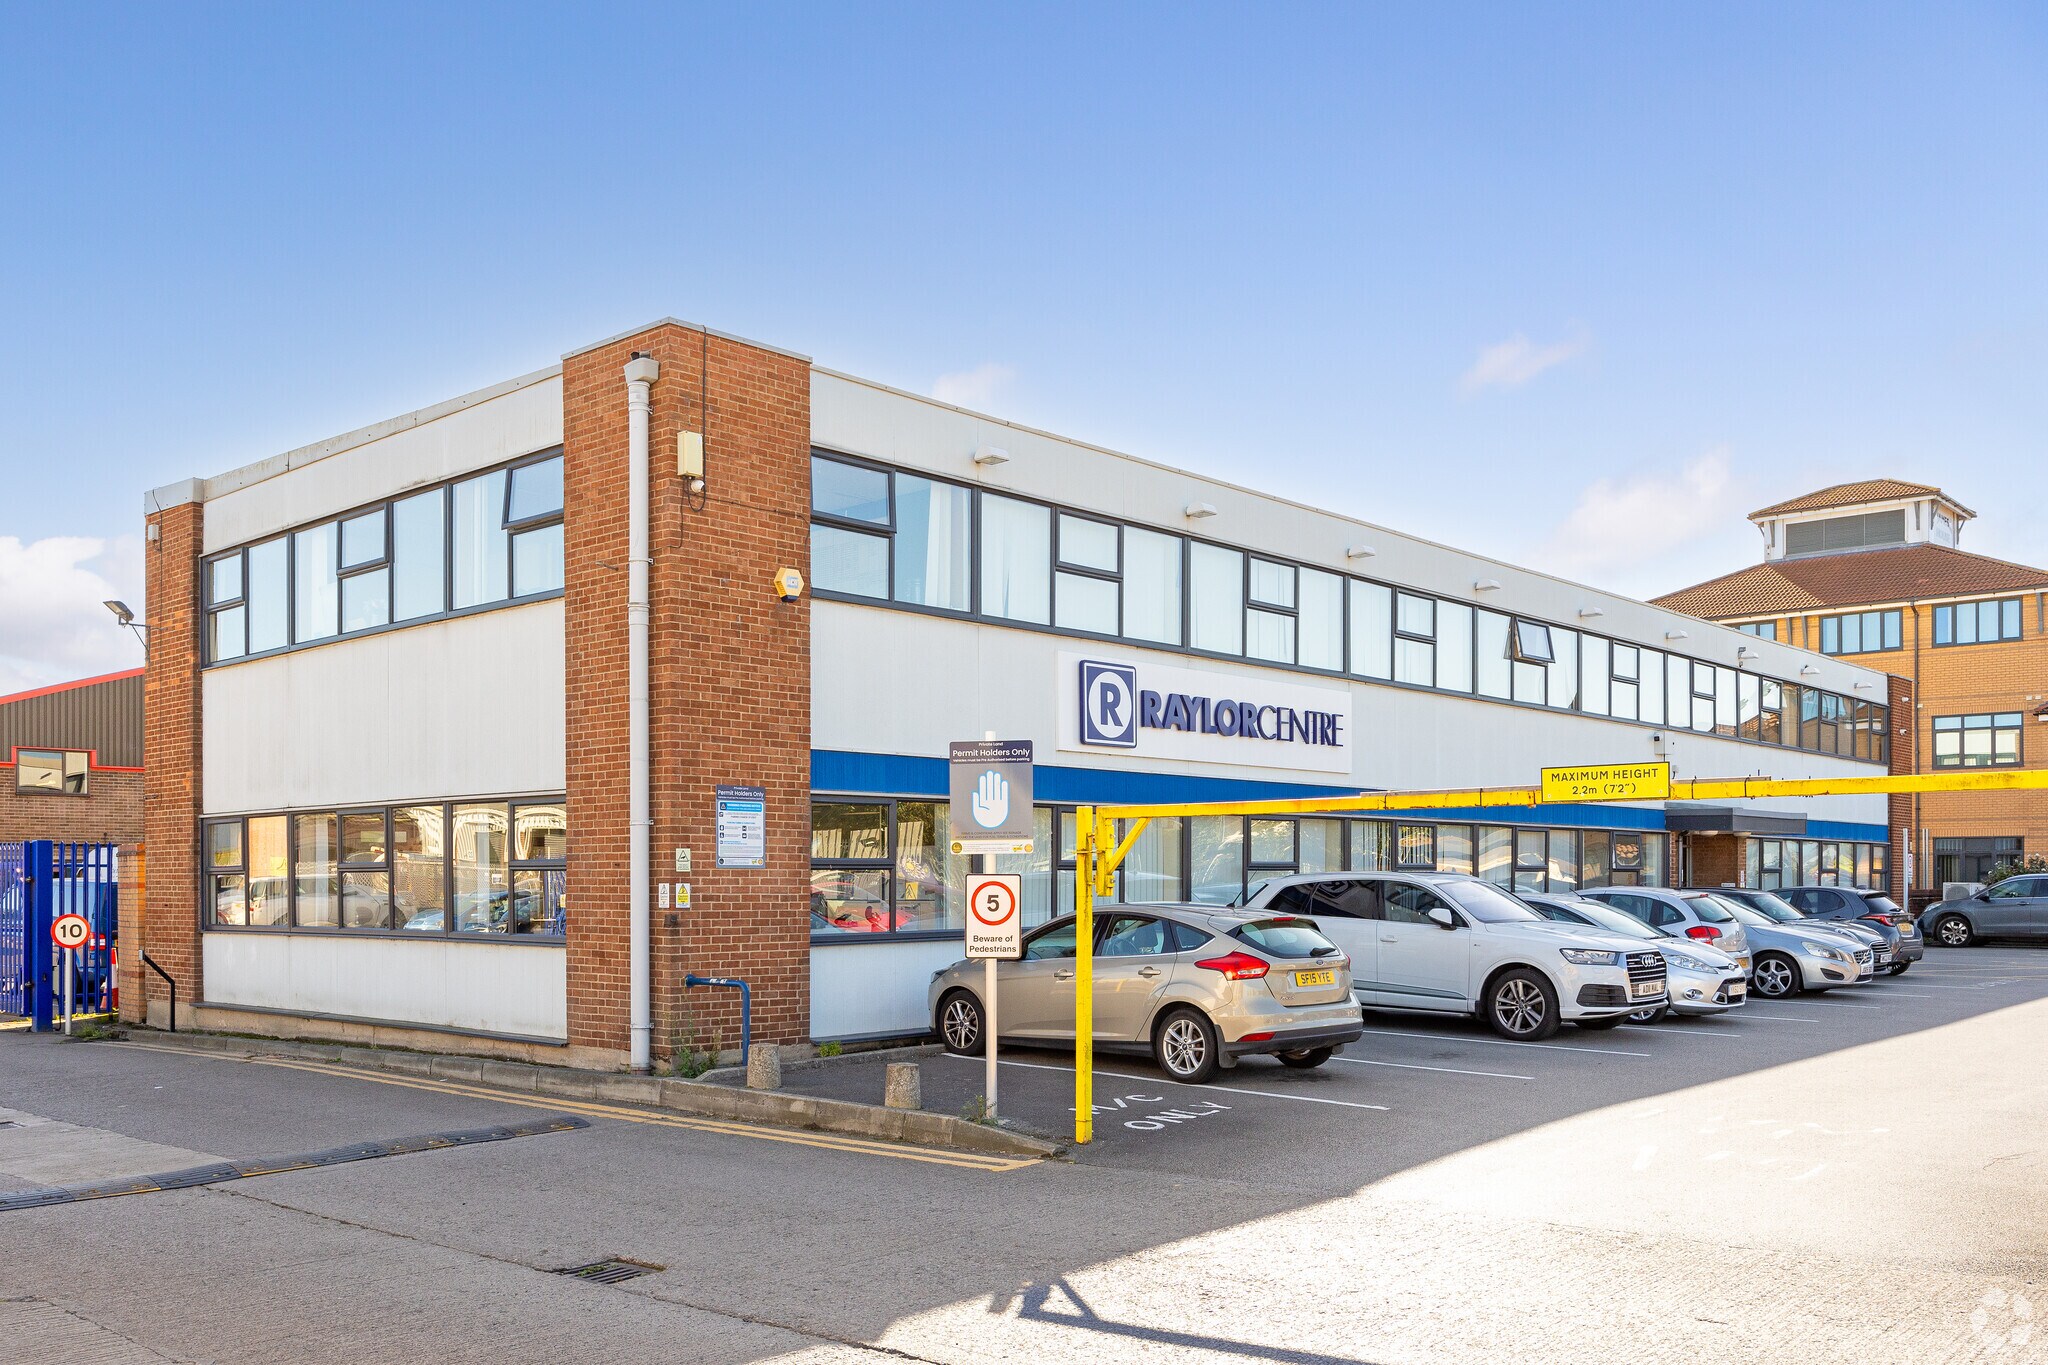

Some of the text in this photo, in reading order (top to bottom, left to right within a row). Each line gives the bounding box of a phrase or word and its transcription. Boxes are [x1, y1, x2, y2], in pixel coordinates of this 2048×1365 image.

[1011, 748, 1030, 758] Only
[1551, 768, 1658, 782] MAXIMUM HEIGHT
[1572, 786, 1598, 795] 2.2m
[986, 894, 1000, 912] 5
[60, 924, 82, 938] 10
[973, 934, 1013, 943] Beware of
[969, 944, 1017, 953] Pedestrians
[1300, 972, 1331, 984] SF15 YTE
[1124, 1101, 1233, 1130] ONLY
